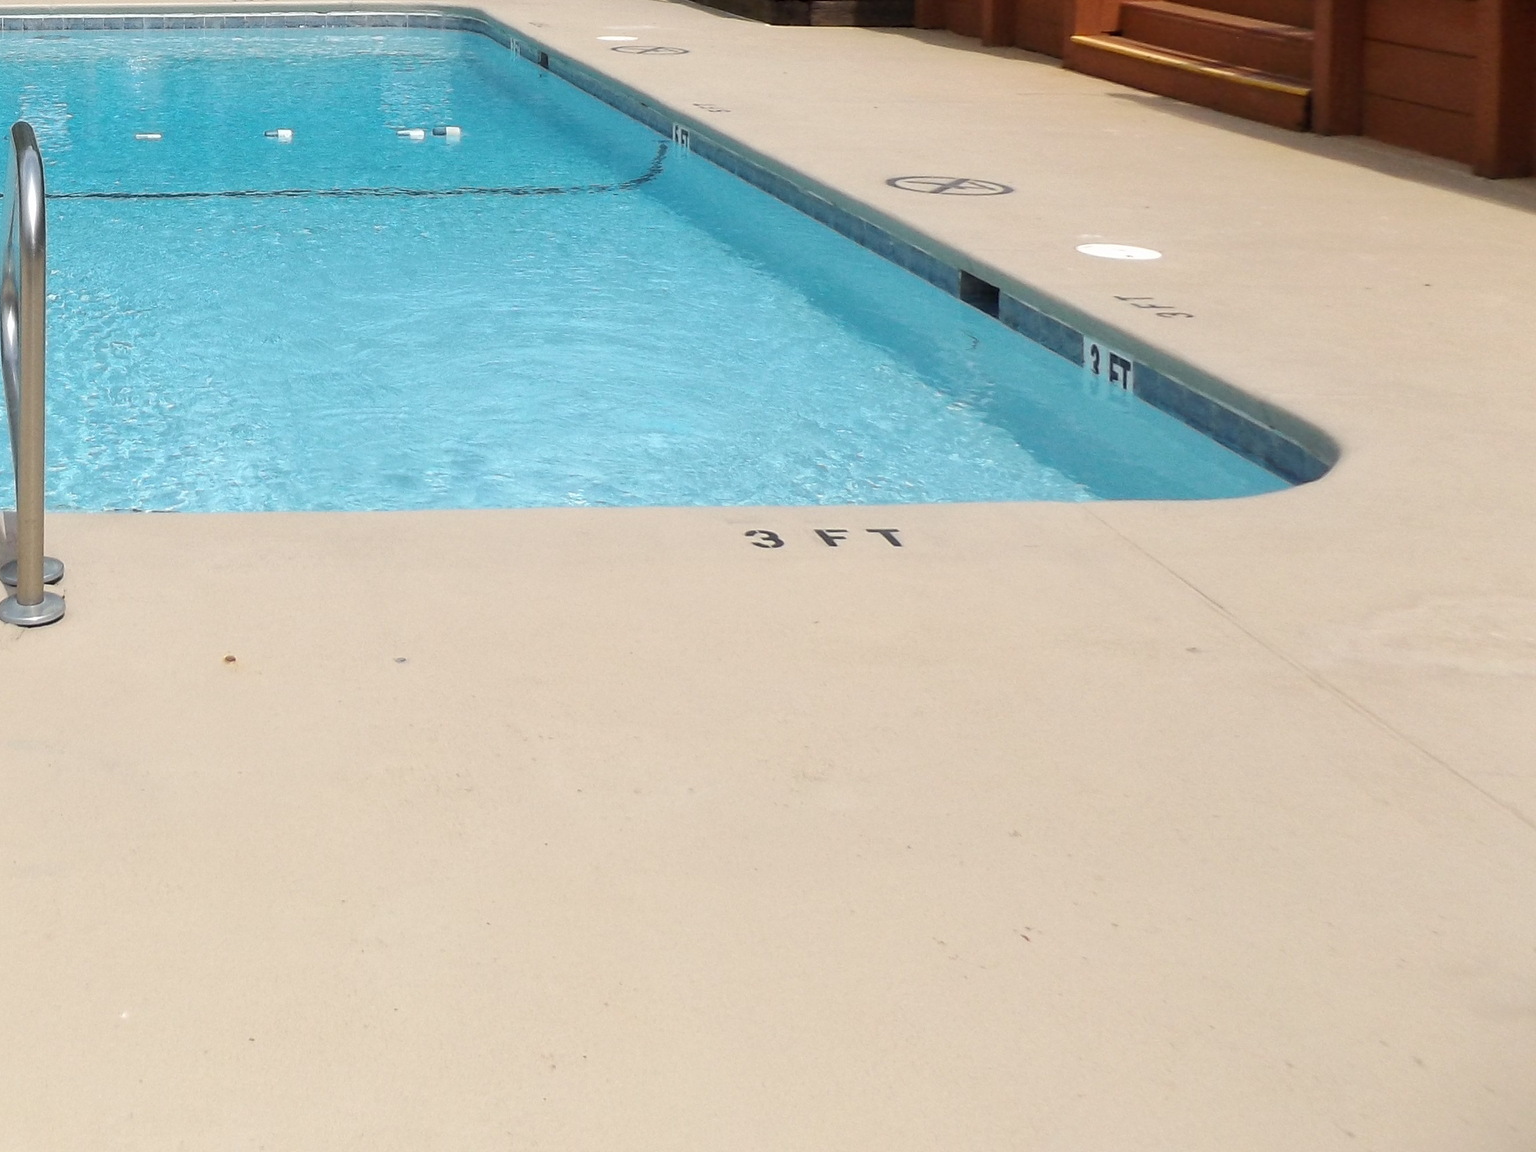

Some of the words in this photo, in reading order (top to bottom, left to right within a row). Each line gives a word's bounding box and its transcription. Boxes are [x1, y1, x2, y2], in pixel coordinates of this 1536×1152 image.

[1090, 343, 1100, 375] 3
[1109, 351, 1132, 390] FT
[744, 529, 785, 548] 3
[814, 528, 903, 547] FT
